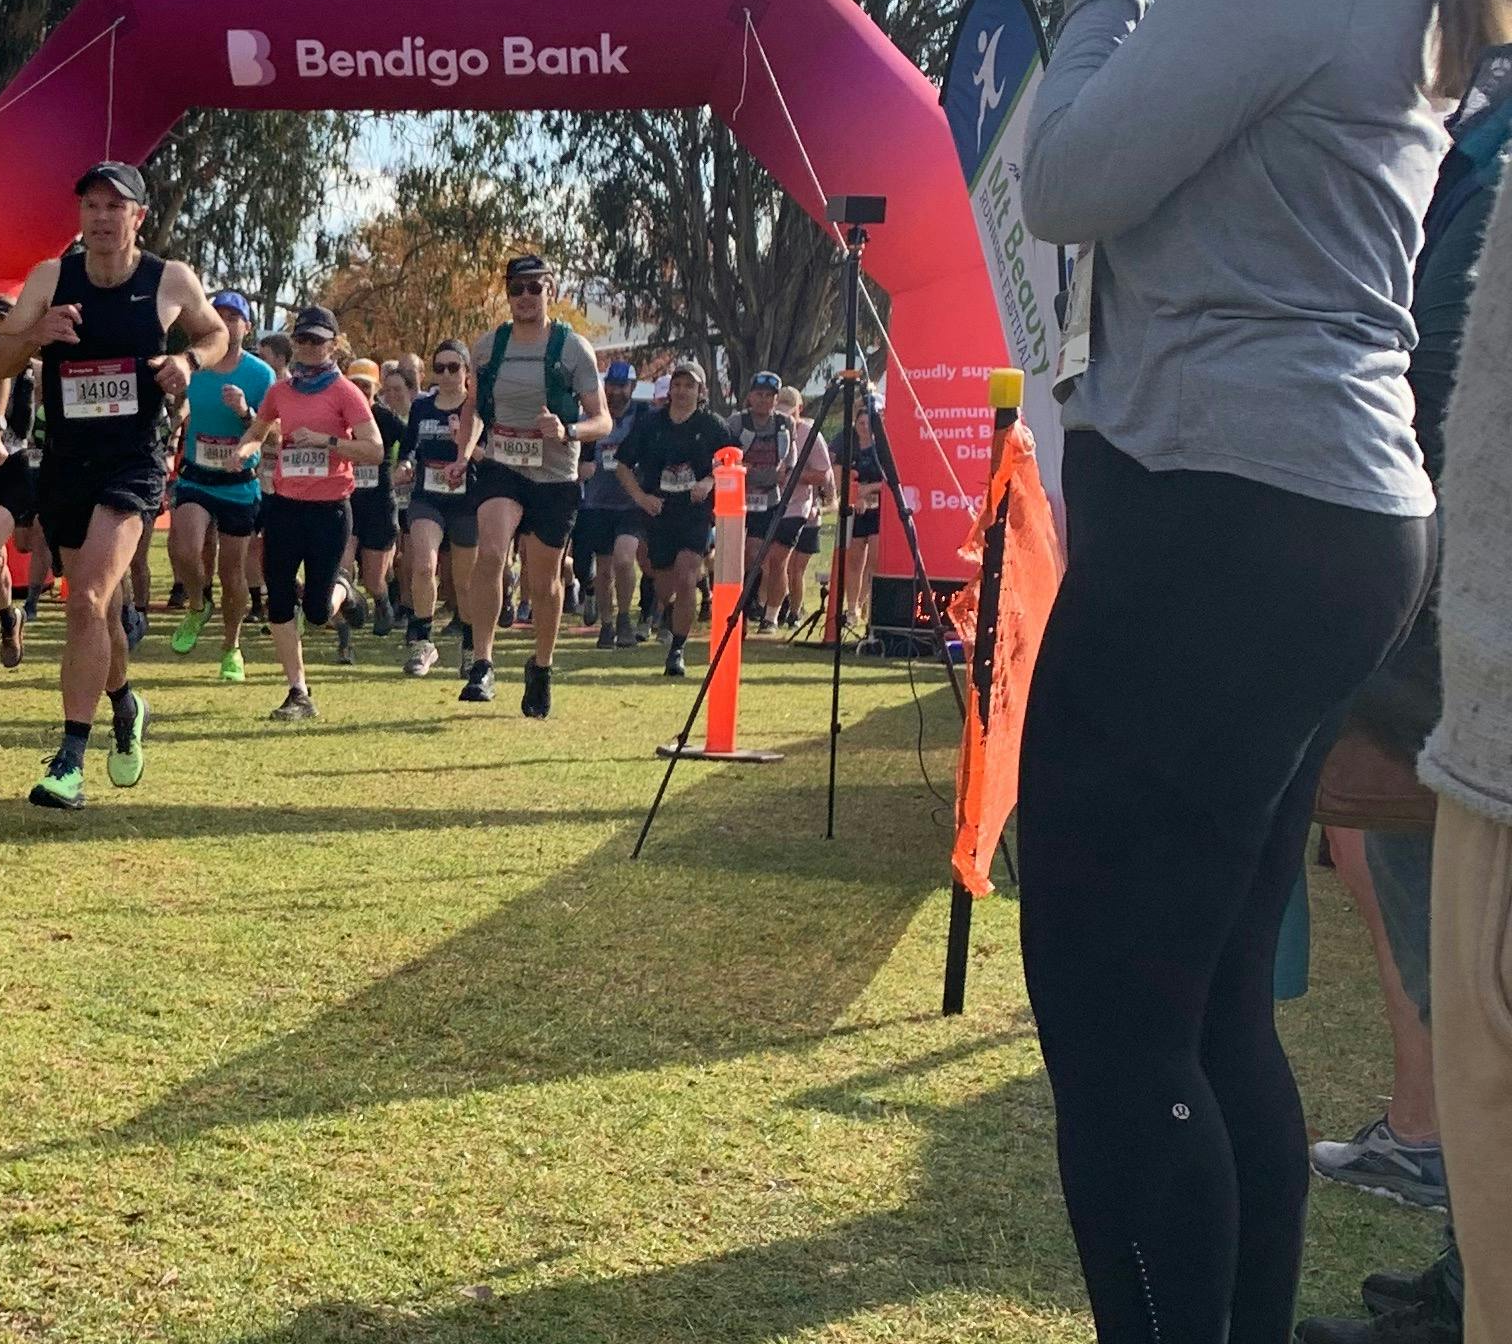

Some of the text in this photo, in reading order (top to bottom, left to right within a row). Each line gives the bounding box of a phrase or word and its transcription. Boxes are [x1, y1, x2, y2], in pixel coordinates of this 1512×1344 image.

[296, 33, 630, 87] Bendigo Bank
[979, 189, 1032, 372] RUNNING FESTIVAL
[988, 156, 1051, 376] Mt Beauty
[80, 379, 130, 399] 14109
